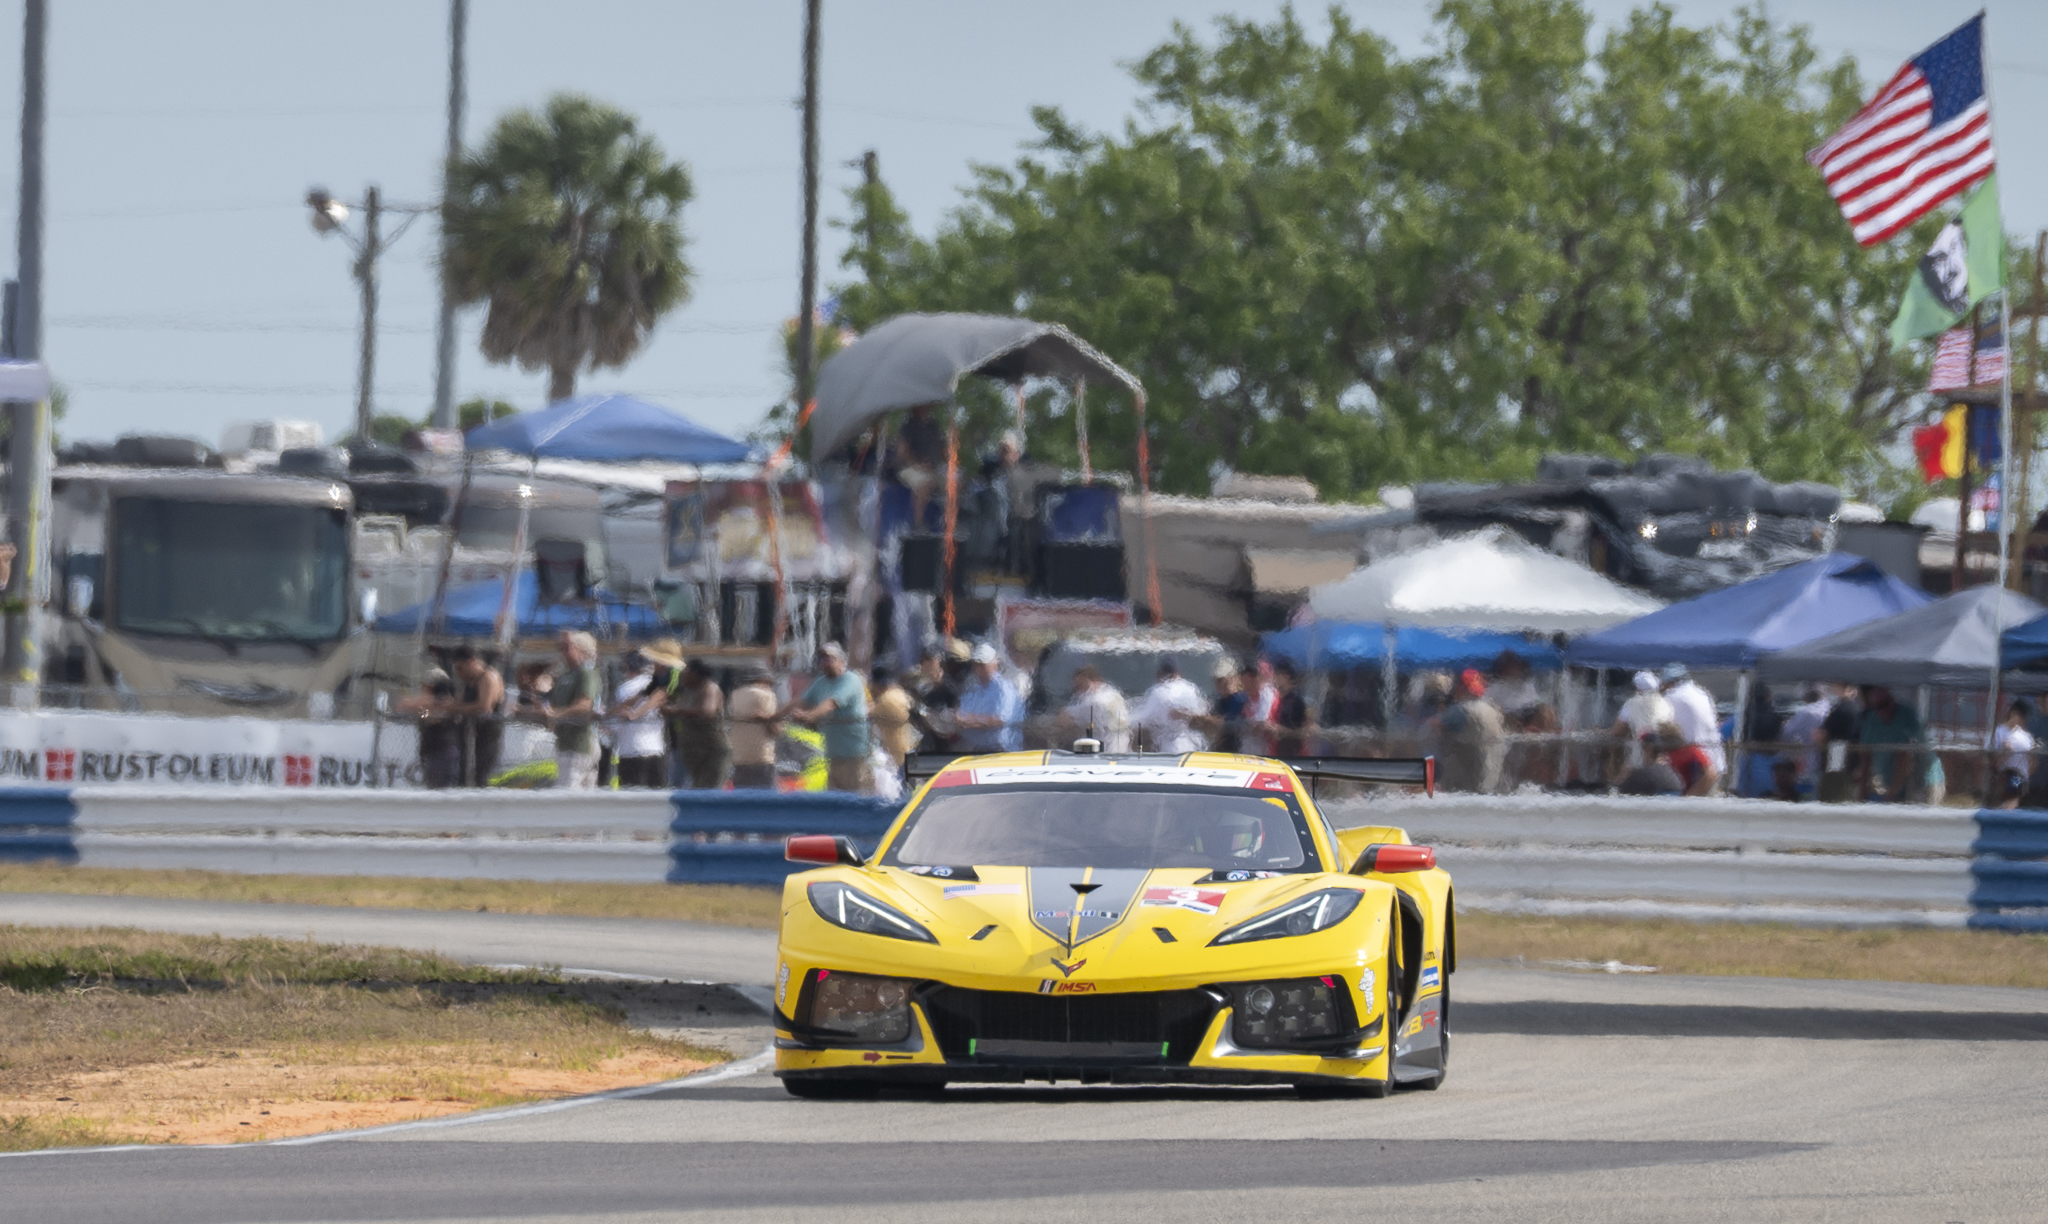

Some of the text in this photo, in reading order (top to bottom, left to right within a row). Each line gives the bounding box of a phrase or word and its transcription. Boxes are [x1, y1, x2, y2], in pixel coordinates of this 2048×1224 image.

[81, 751, 276, 784] RUST-OLEUM
[986, 770, 1238, 780] CORVETTE
[1168, 889, 1199, 901] 3
[1057, 982, 1096, 992] IMSA
